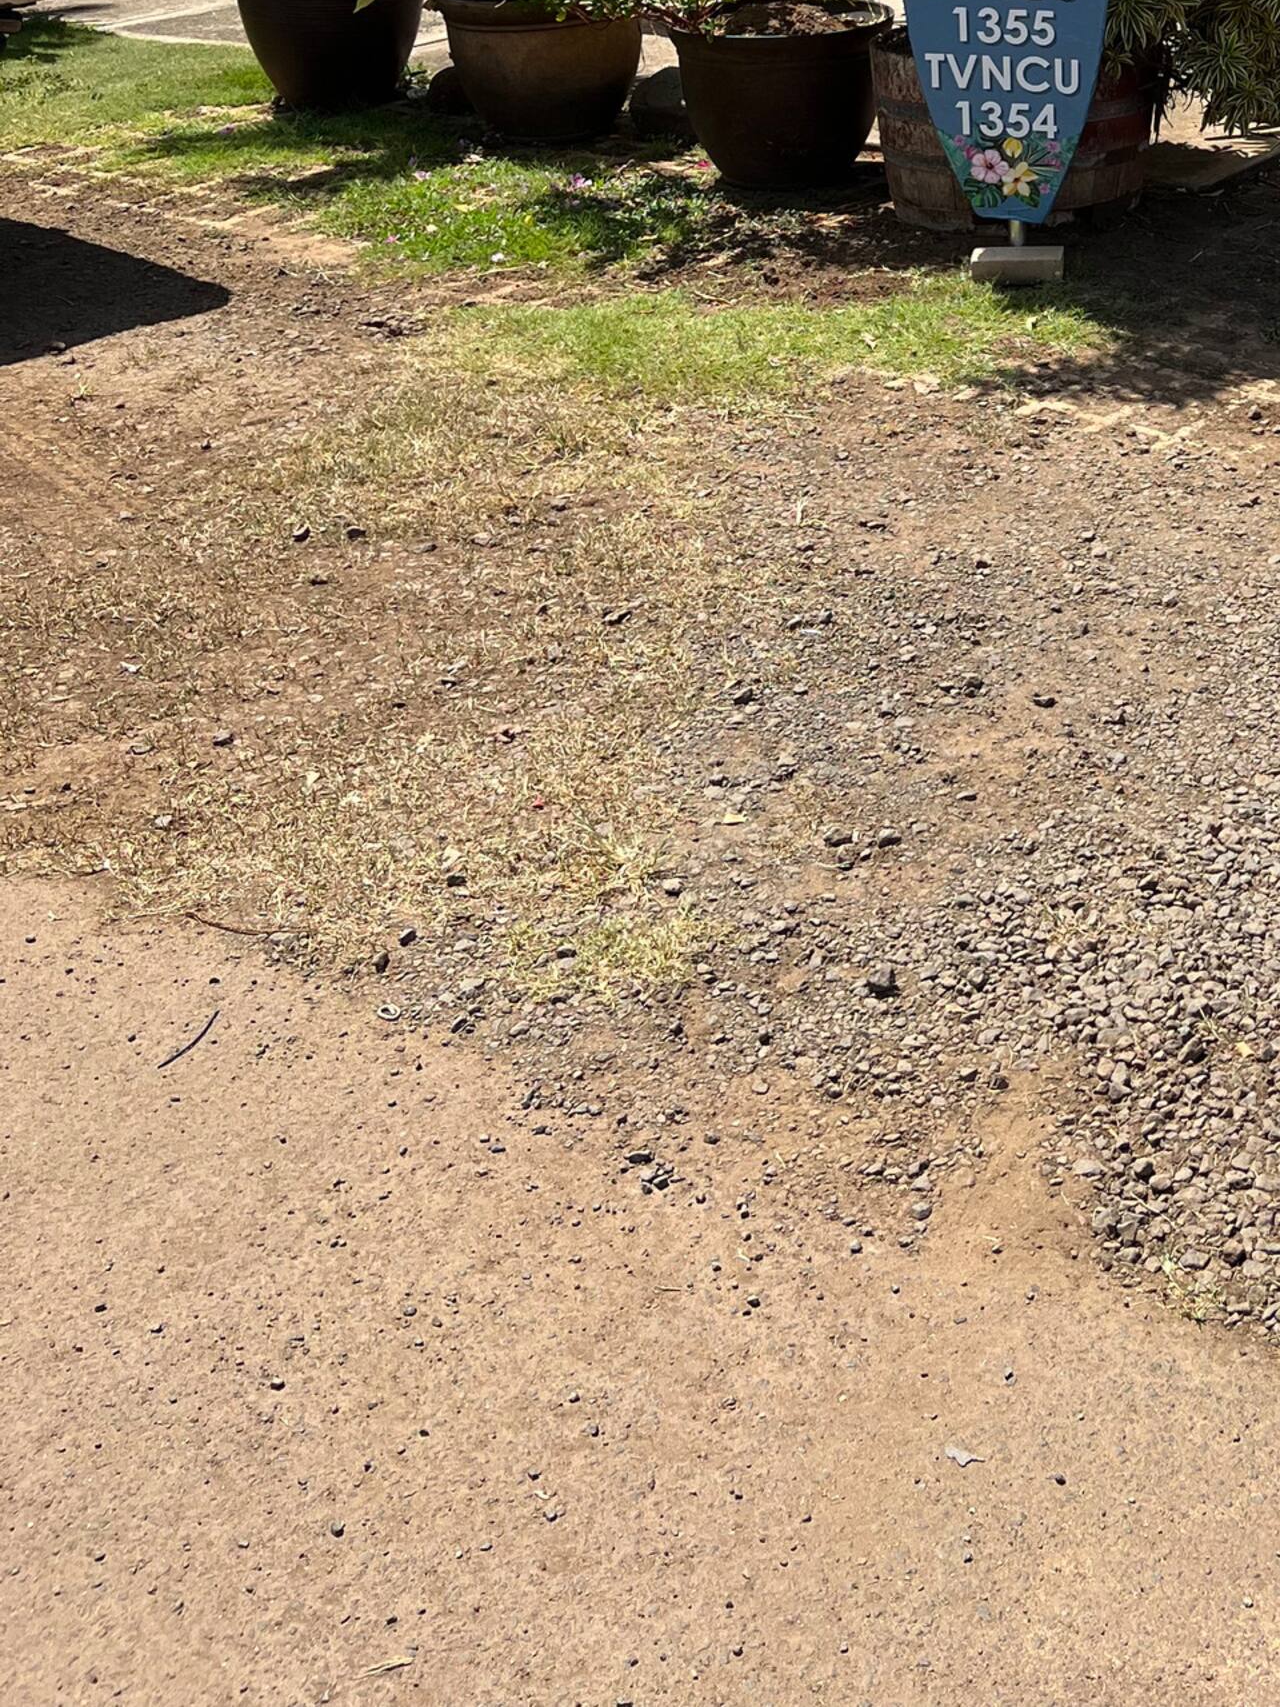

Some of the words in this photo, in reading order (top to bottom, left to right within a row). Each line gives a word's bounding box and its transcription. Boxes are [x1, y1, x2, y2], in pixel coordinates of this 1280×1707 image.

[952, 7, 1055, 46] 1355
[925, 53, 1079, 95] TVNCU
[955, 101, 1057, 139] 1354
